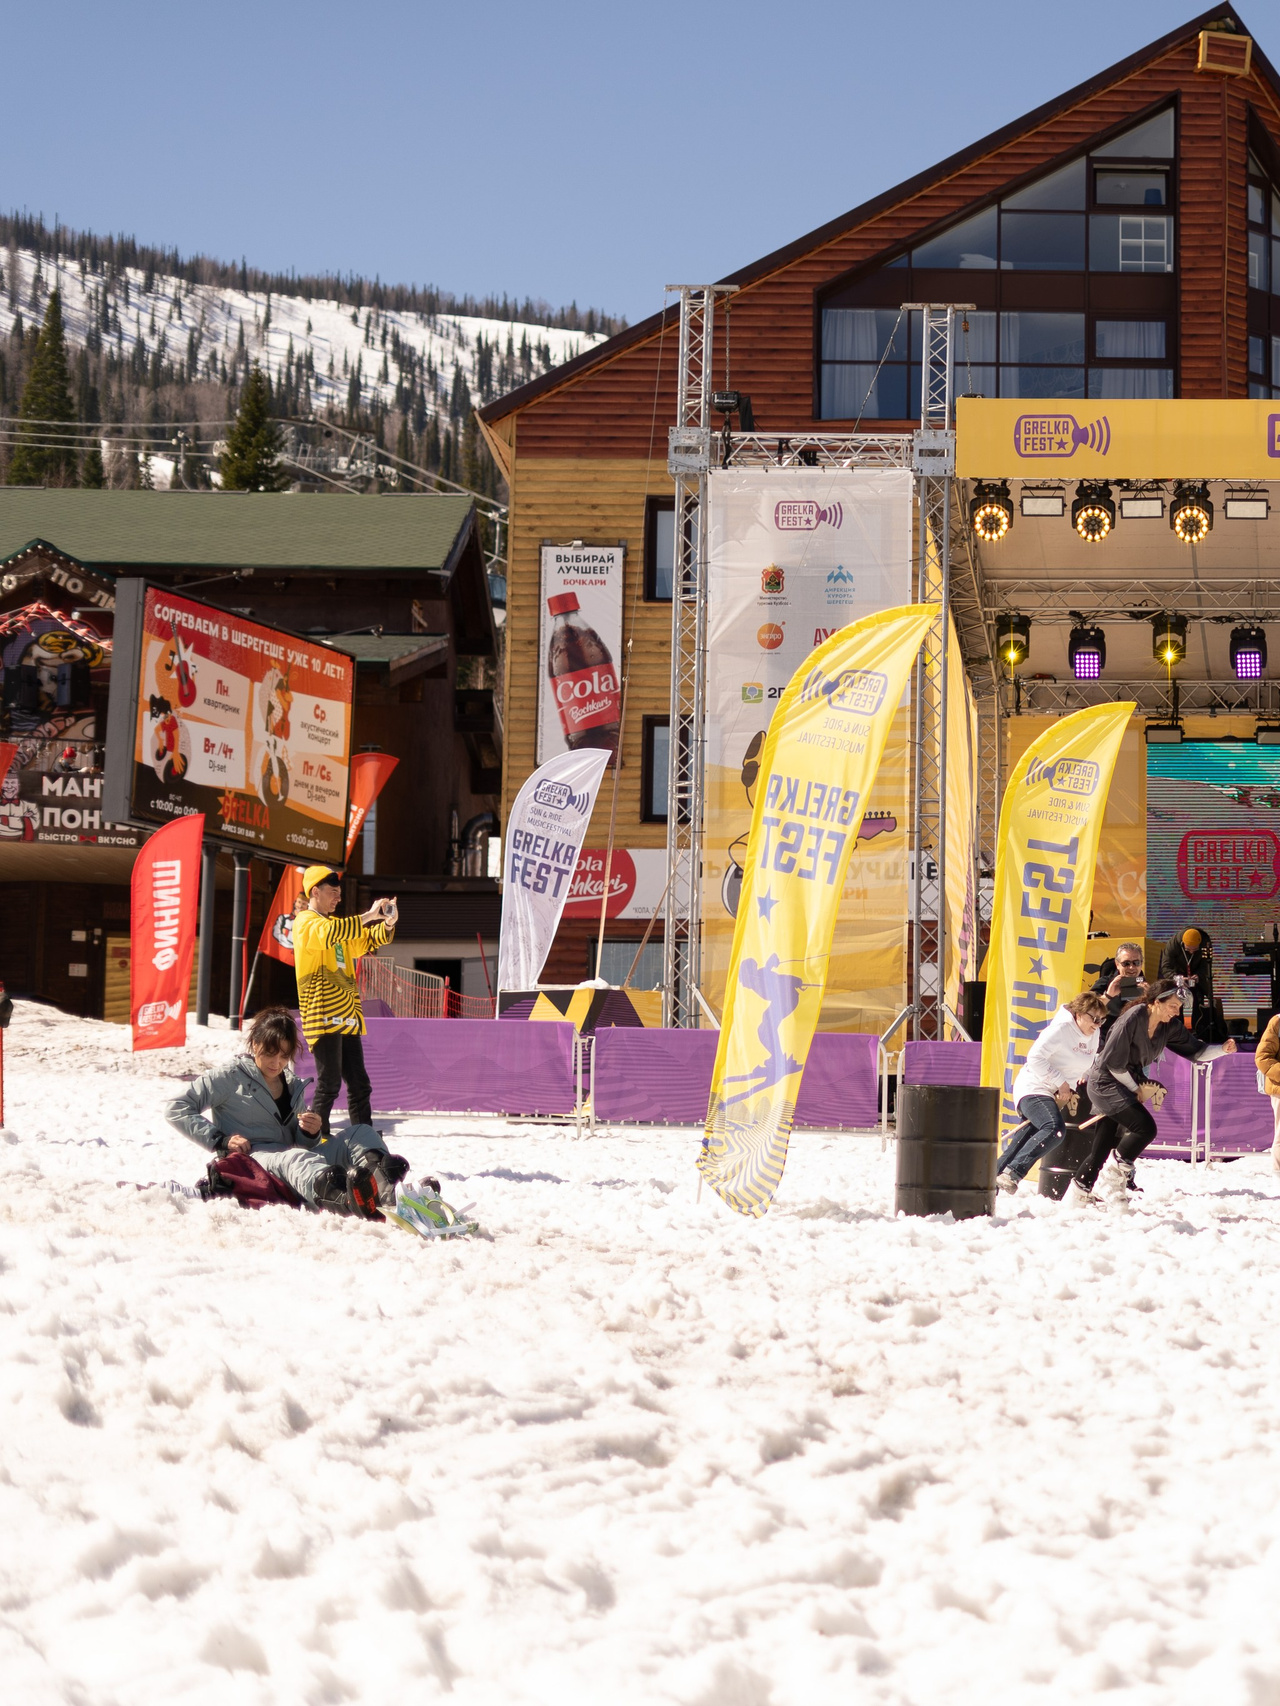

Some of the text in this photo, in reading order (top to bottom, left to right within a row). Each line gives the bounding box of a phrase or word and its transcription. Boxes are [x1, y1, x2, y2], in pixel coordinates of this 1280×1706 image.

[1023, 420, 1069, 436] GRELKA
[1023, 437, 1054, 452] FEST
[781, 504, 814, 516] GRELKA
[781, 516, 803, 527] FEST
[555, 552, 615, 564] ВЫБИРАЙ
[50, 568, 84, 594] ПО
[563, 578, 607, 586] БОЧКАРИ
[154, 603, 345, 680] СОГРЕВАЕМ В ШЕРЕГЕШЕ УЖЕ 10 ЛЕТ!
[215, 679, 230, 696] Пн.
[556, 671, 617, 704] Cola
[203, 697, 240, 715] квартирник
[313, 703, 328, 723] Ср.
[568, 697, 613, 723] Bochkari
[300, 721, 340, 739] акустический
[307, 732, 331, 746] концерт
[208, 759, 227, 773] Dj-set
[42, 775, 104, 798] МАН
[293, 779, 309, 791] днем
[315, 784, 340, 798] вечером
[541, 782, 568, 798] GRELKA
[307, 790, 326, 804] Dj-sets
[538, 791, 558, 805] FEST
[156, 800, 174, 813] 10:00
[174, 805, 183, 815] до
[221, 795, 270, 830] GRELKA
[529, 806, 542, 817] SUN
[548, 810, 563, 823] RIDE
[221, 823, 256, 839] APRES SKI BAR
[527, 817, 572, 837] MUSIC FESTIVAL
[38, 832, 78, 842] БЫСТРО
[98, 836, 137, 845] ВКУСНО
[291, 834, 306, 846] 10:00
[307, 839, 315, 848] до
[315, 838, 328, 851] 2:00
[513, 829, 577, 867] GRELKA
[1194, 839, 1267, 863] GRELKA
[575, 856, 603, 871] ola
[511, 853, 570, 898] FEST
[1194, 867, 1242, 889] FEST
[566, 874, 628, 898] chkari
[152, 860, 181, 971] ФИНИШ
